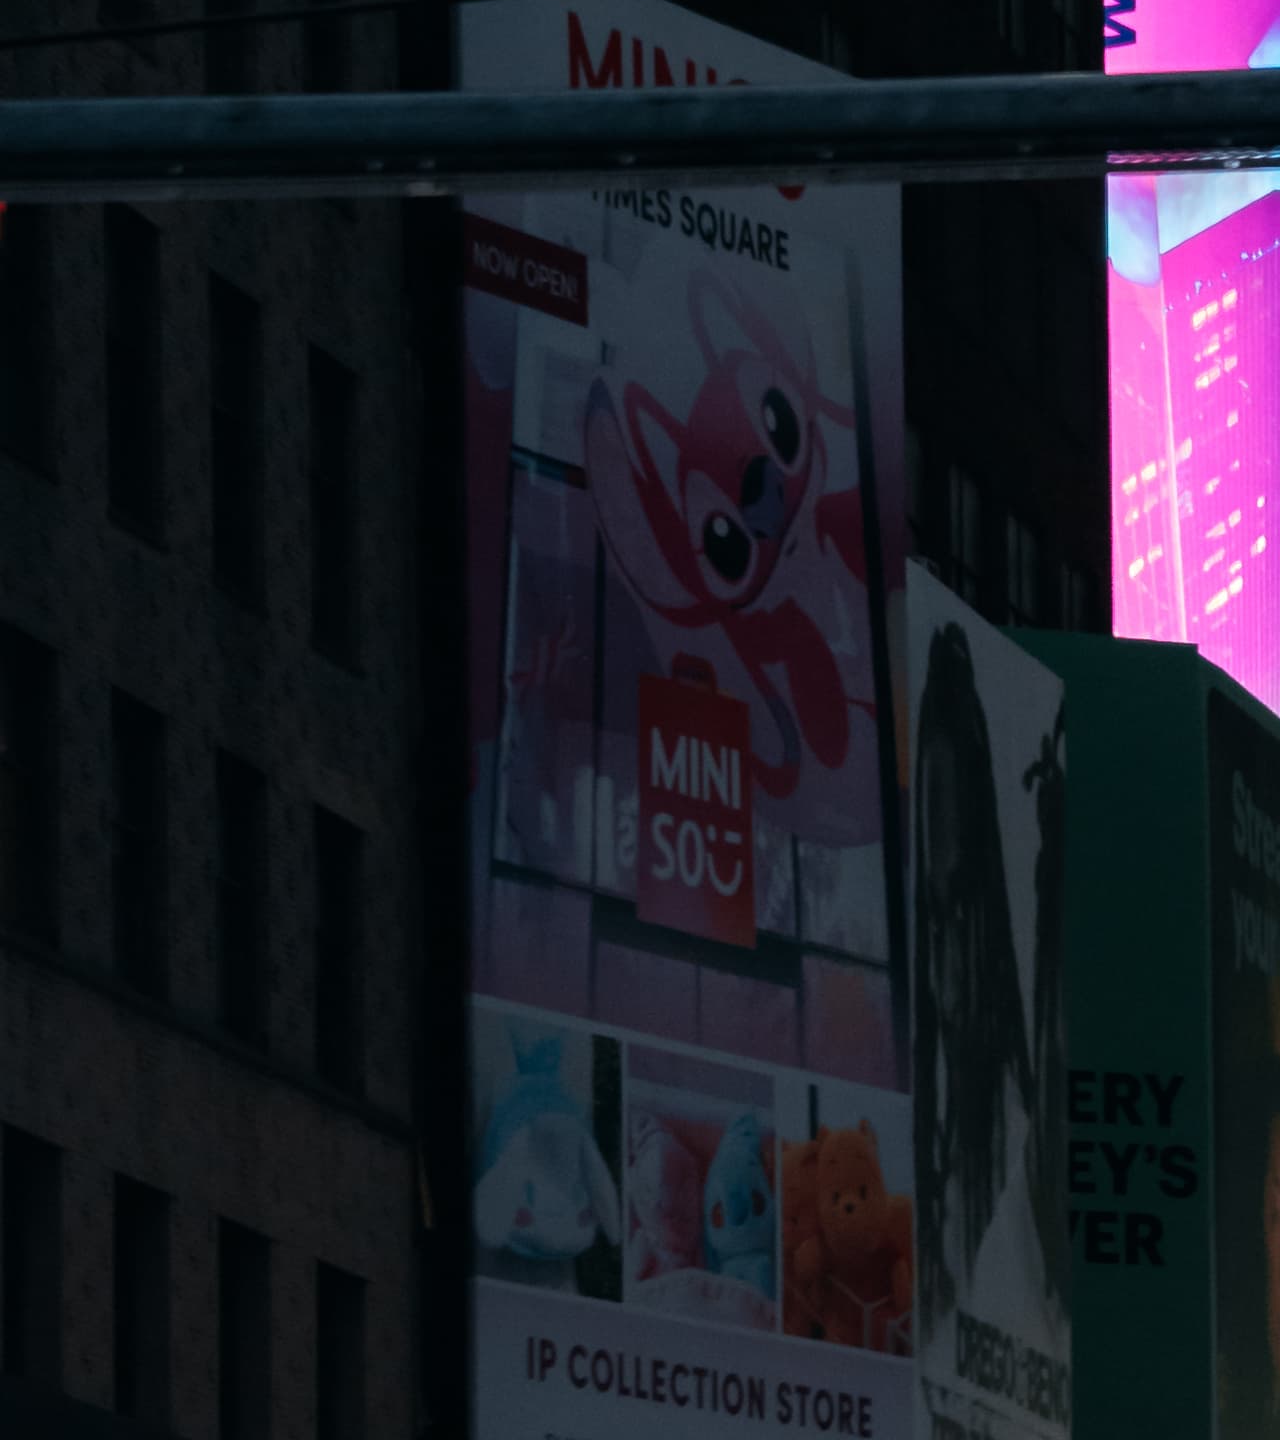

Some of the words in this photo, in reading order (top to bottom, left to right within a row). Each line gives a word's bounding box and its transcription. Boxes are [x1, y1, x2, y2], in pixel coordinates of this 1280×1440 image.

[680, 196, 790, 271] SQUARE
[472, 241, 518, 281] NOW
[523, 261, 579, 304] OPEN!
[650, 726, 742, 810] MINI
[1069, 1141, 1198, 1199] EY'S
[1070, 1211, 1165, 1266] ER
[527, 1336, 557, 1382] IP
[568, 1344, 765, 1421] COLLECTION
[777, 1382, 873, 1438] STORE
